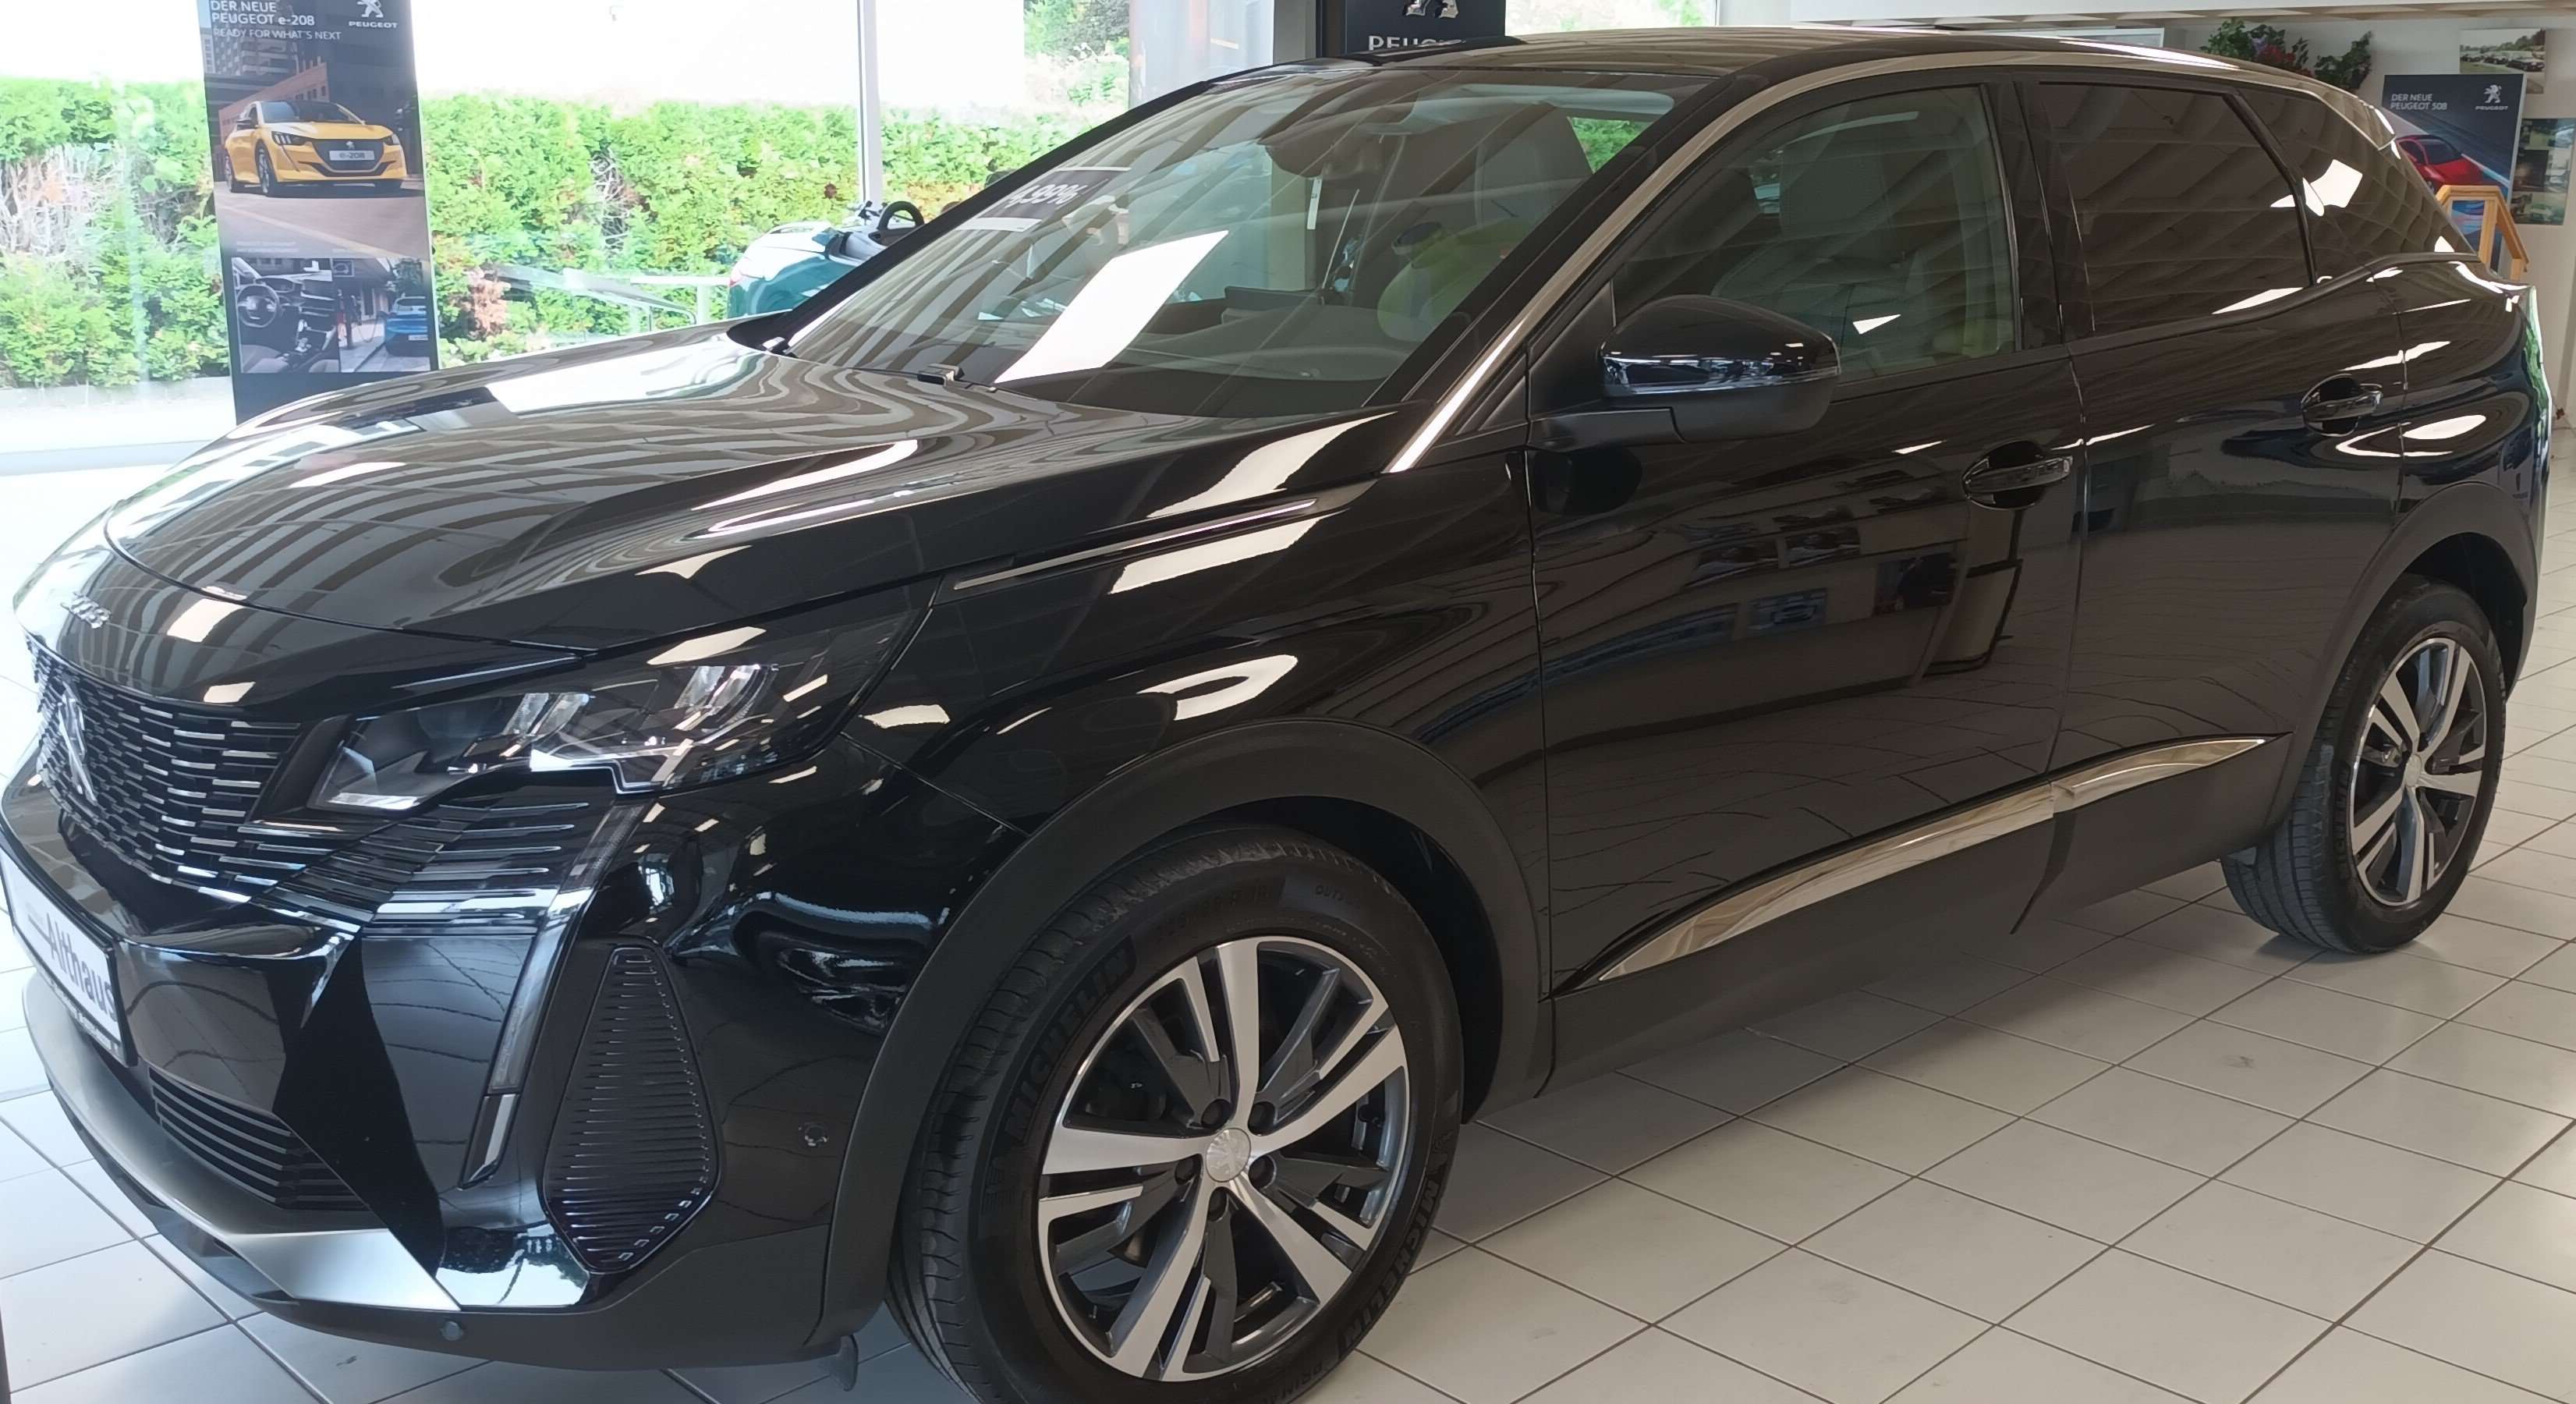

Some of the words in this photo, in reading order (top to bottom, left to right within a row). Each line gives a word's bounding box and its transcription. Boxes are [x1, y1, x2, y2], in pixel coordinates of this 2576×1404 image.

[210, 1, 237, 12] DER
[240, 1, 277, 12] NEUE
[211, 13, 274, 24] PEUGEOT
[278, 15, 315, 26] e-208
[349, 20, 398, 29] PEUGEOT
[213, 28, 246, 38] READY
[250, 29, 271, 39] FOR
[315, 31, 342, 40] NEXT
[1004, 947, 1131, 1145] MICHELIN
[1342, 1179, 1441, 1346] MICHELIN
